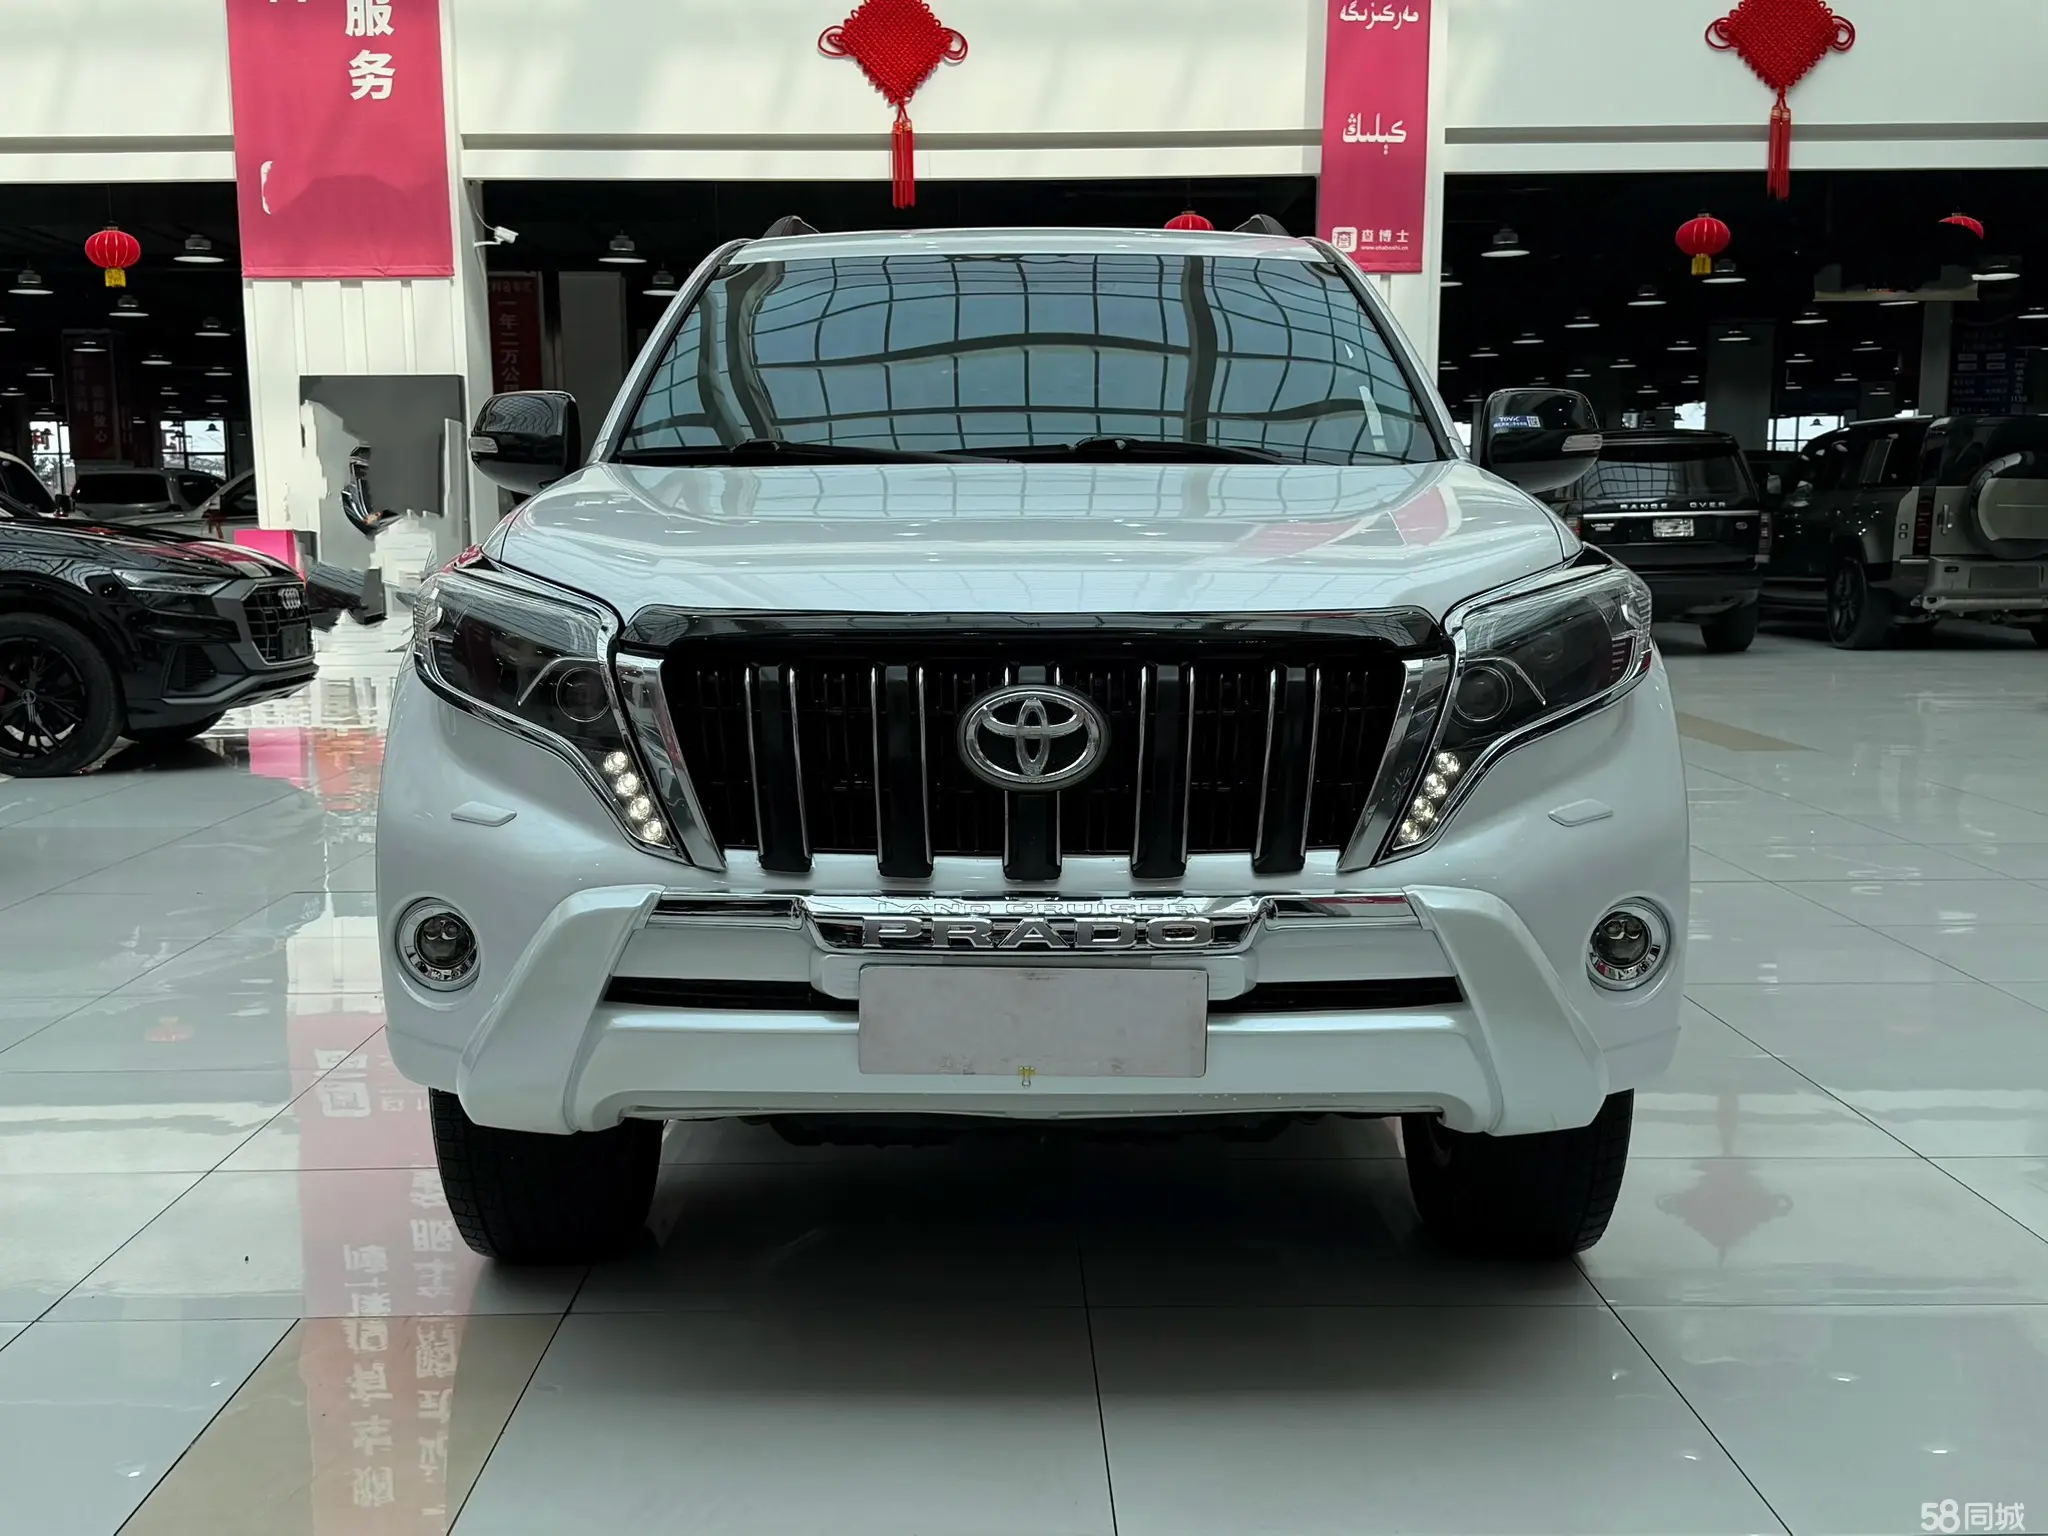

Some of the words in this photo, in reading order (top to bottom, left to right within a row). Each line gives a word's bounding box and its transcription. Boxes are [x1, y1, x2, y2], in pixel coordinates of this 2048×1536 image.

[345, 0, 396, 100] 服务
[1620, 502, 1668, 510] RANGE
[878, 902, 991, 915] LAND
[1005, 902, 1198, 915] CRUISER
[862, 916, 1215, 949] PRADO
